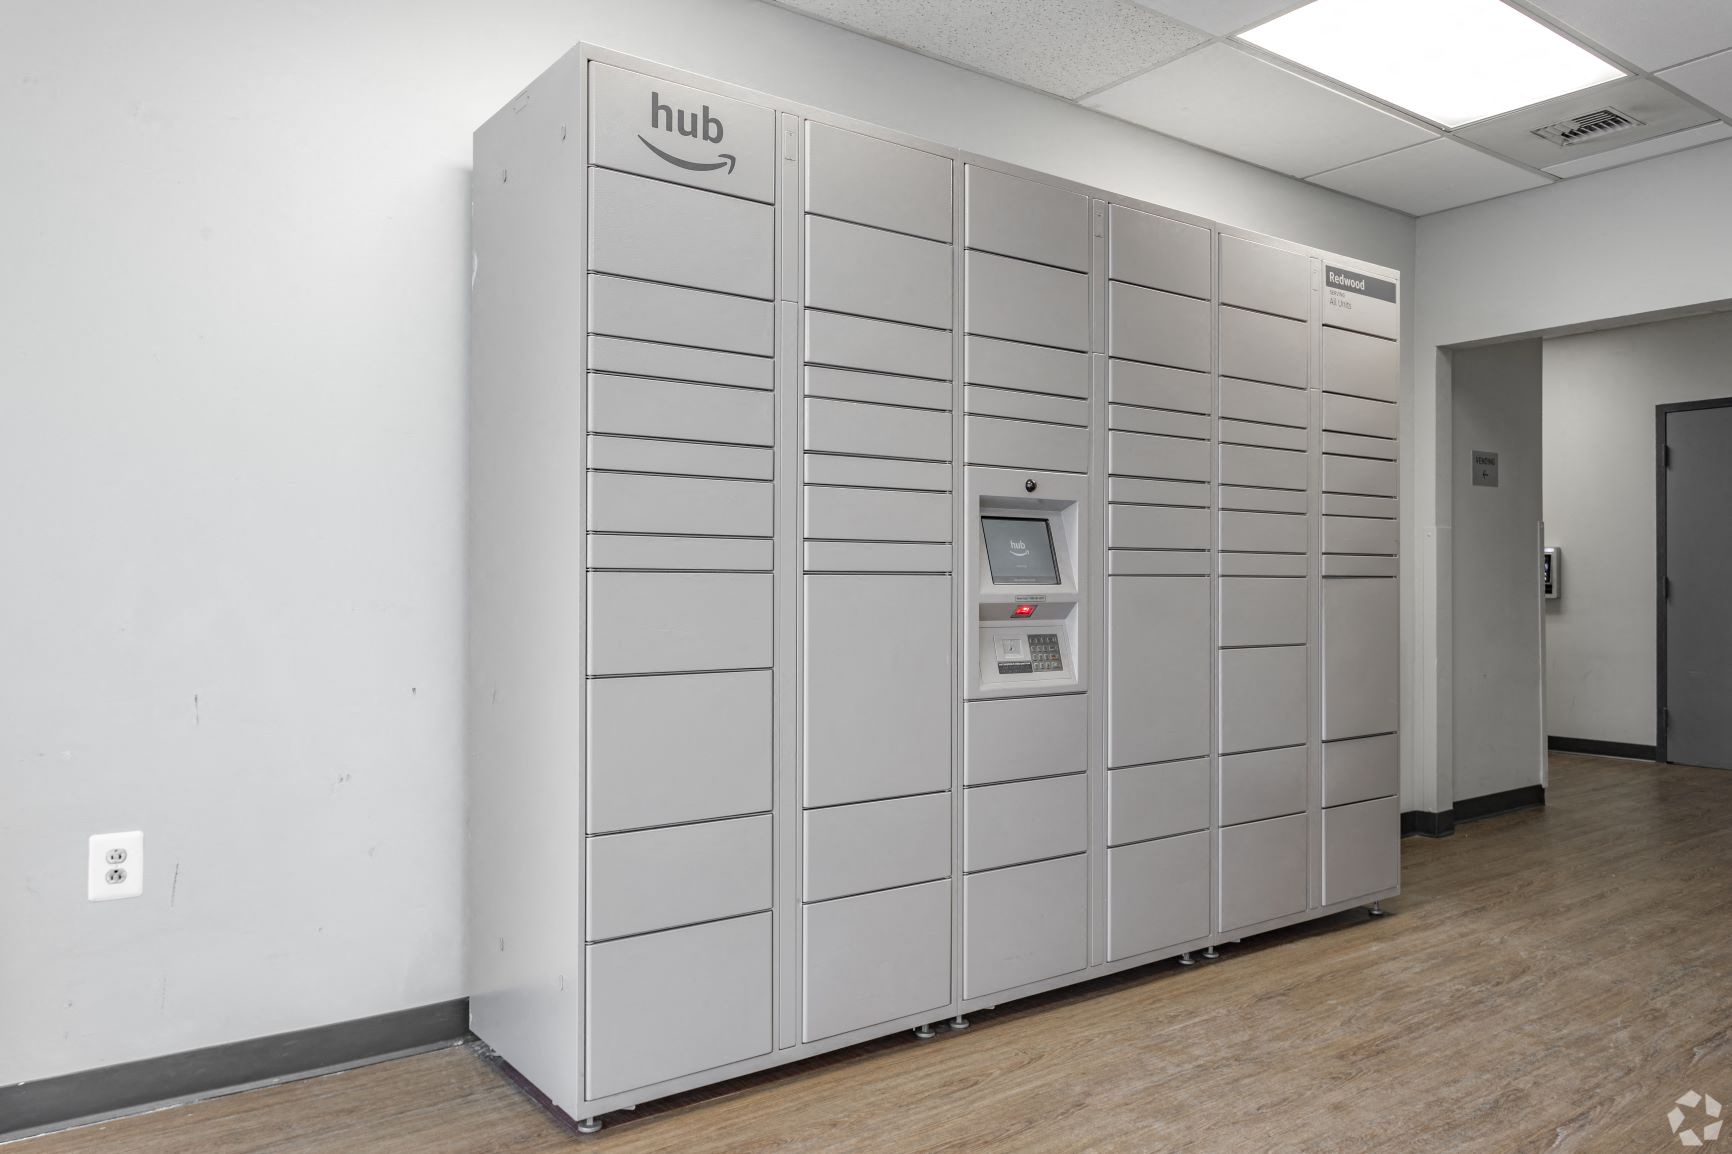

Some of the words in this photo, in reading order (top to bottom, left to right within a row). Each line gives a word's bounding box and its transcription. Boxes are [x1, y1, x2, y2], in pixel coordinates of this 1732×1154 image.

[651, 91, 724, 144] hub
[1329, 271, 1366, 290] Redwood
[1329, 297, 1337, 306] All
[1337, 299, 1352, 310] Units
[1009, 539, 1026, 550] hub
